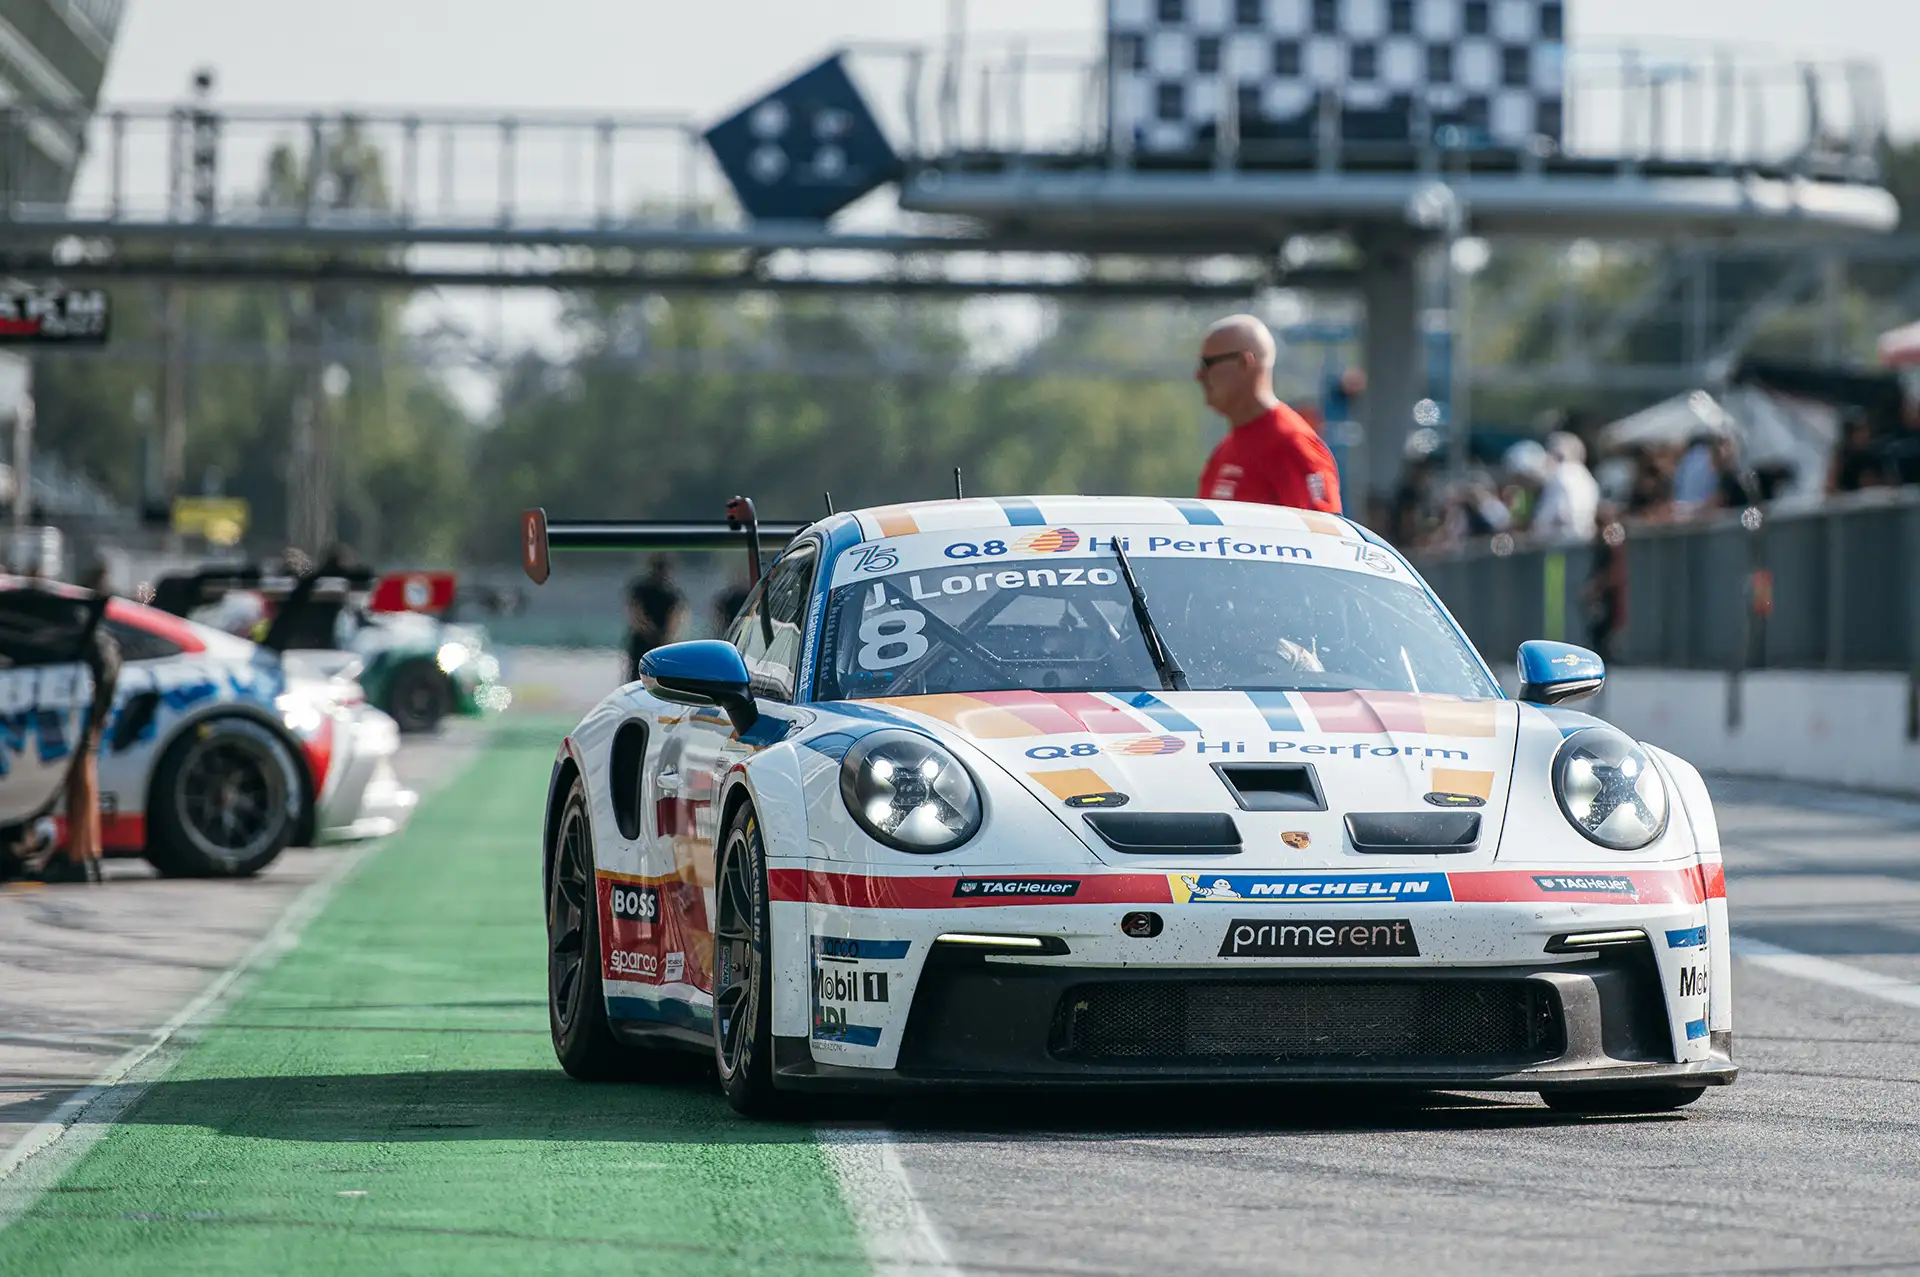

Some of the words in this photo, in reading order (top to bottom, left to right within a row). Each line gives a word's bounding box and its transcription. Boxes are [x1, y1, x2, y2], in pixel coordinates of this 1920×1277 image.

[850, 545, 899, 572] 75
[944, 540, 1008, 558] Q8
[1089, 535, 1130, 552] Hi
[1148, 536, 1313, 559] Perform
[864, 582, 900, 611] J.
[910, 568, 1118, 600] Lorenzo
[858, 609, 929, 671] 8
[1024, 742, 1099, 761] Q8
[1197, 740, 1245, 755] Hi
[1268, 740, 1469, 761] Perform
[1250, 881, 1430, 895] MICHELIN
[615, 889, 656, 918] BOSS
[1233, 922, 1406, 954] primerent
[610, 949, 658, 974] sparco
